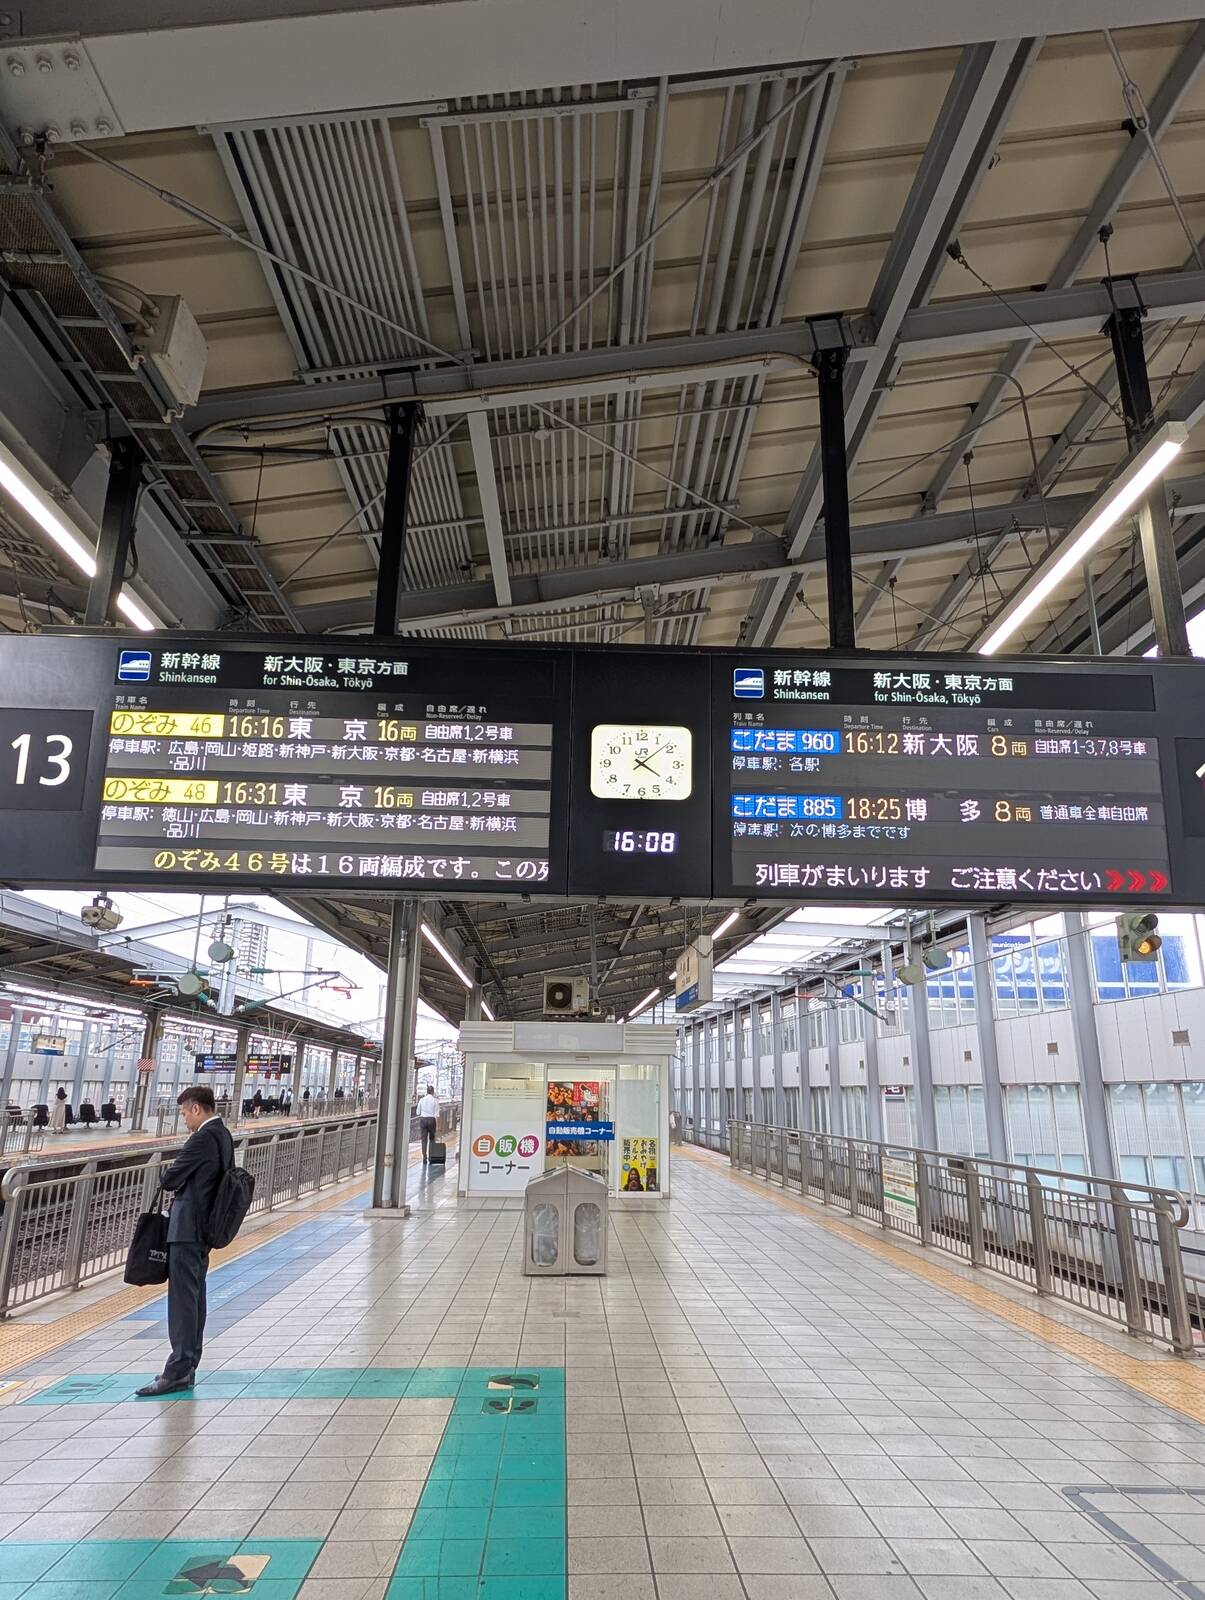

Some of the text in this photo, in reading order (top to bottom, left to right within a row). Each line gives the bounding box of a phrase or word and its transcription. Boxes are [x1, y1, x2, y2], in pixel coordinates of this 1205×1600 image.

[160, 652, 221, 670] 新幹線
[263, 655, 408, 676] 新大阪・東京方面
[159, 671, 217, 685] Shinkansen
[263, 674, 373, 690] for Shin-Ōsaka, Tōkyō
[773, 669, 832, 687] 新幹線
[873, 672, 1013, 691] 新大阪・東京方面
[773, 688, 830, 701] Shinkansen
[874, 691, 981, 707] for Shin-Ōsaka, Tōkyō
[112, 713, 178, 734] のぞみ
[190, 716, 212, 734] 46
[229, 715, 284, 738] 16:16
[378, 719, 417, 742] 16両
[425, 723, 513, 742] 自由席1,2号車
[902, 724, 932, 732] Destination
[622, 737, 632, 745] 11
[636, 732, 648, 741] 12
[655, 736, 660, 744] 1
[732, 730, 796, 751] こだま
[801, 733, 834, 751] 960
[844, 732, 899, 754] 16:12
[902, 732, 979, 756] 新大阪
[991, 735, 1028, 758] 8両
[609, 746, 621, 755] 10
[635, 748, 649, 756] JR
[666, 745, 674, 754] 2
[11, 733, 73, 786] 13
[603, 759, 611, 767] 9
[672, 761, 681, 769] 3
[789, 756, 820, 772] 各駅
[609, 775, 617, 783] 8
[665, 776, 674, 784] 4
[105, 779, 171, 801] のぞみ
[183, 783, 206, 801] 48
[223, 781, 278, 805] 16:31
[374, 786, 414, 808] 16両
[421, 790, 511, 809] 自由席1,2号車
[623, 784, 631, 792] 7
[638, 787, 646, 796] 6
[652, 785, 660, 793] 5
[733, 796, 797, 817] こだま
[803, 798, 836, 817] 885
[847, 797, 901, 820] 18:25
[994, 800, 1032, 822] 8両
[1039, 804, 1148, 822] 普通車全車自由席
[790, 823, 911, 839] 次の博多までです
[614, 831, 676, 853] 16:08
[755, 863, 1101, 892] 列車がまいります ご注意ください
[478, 1138, 535, 1154] 自販機
[479, 1160, 530, 1176] コーナー
